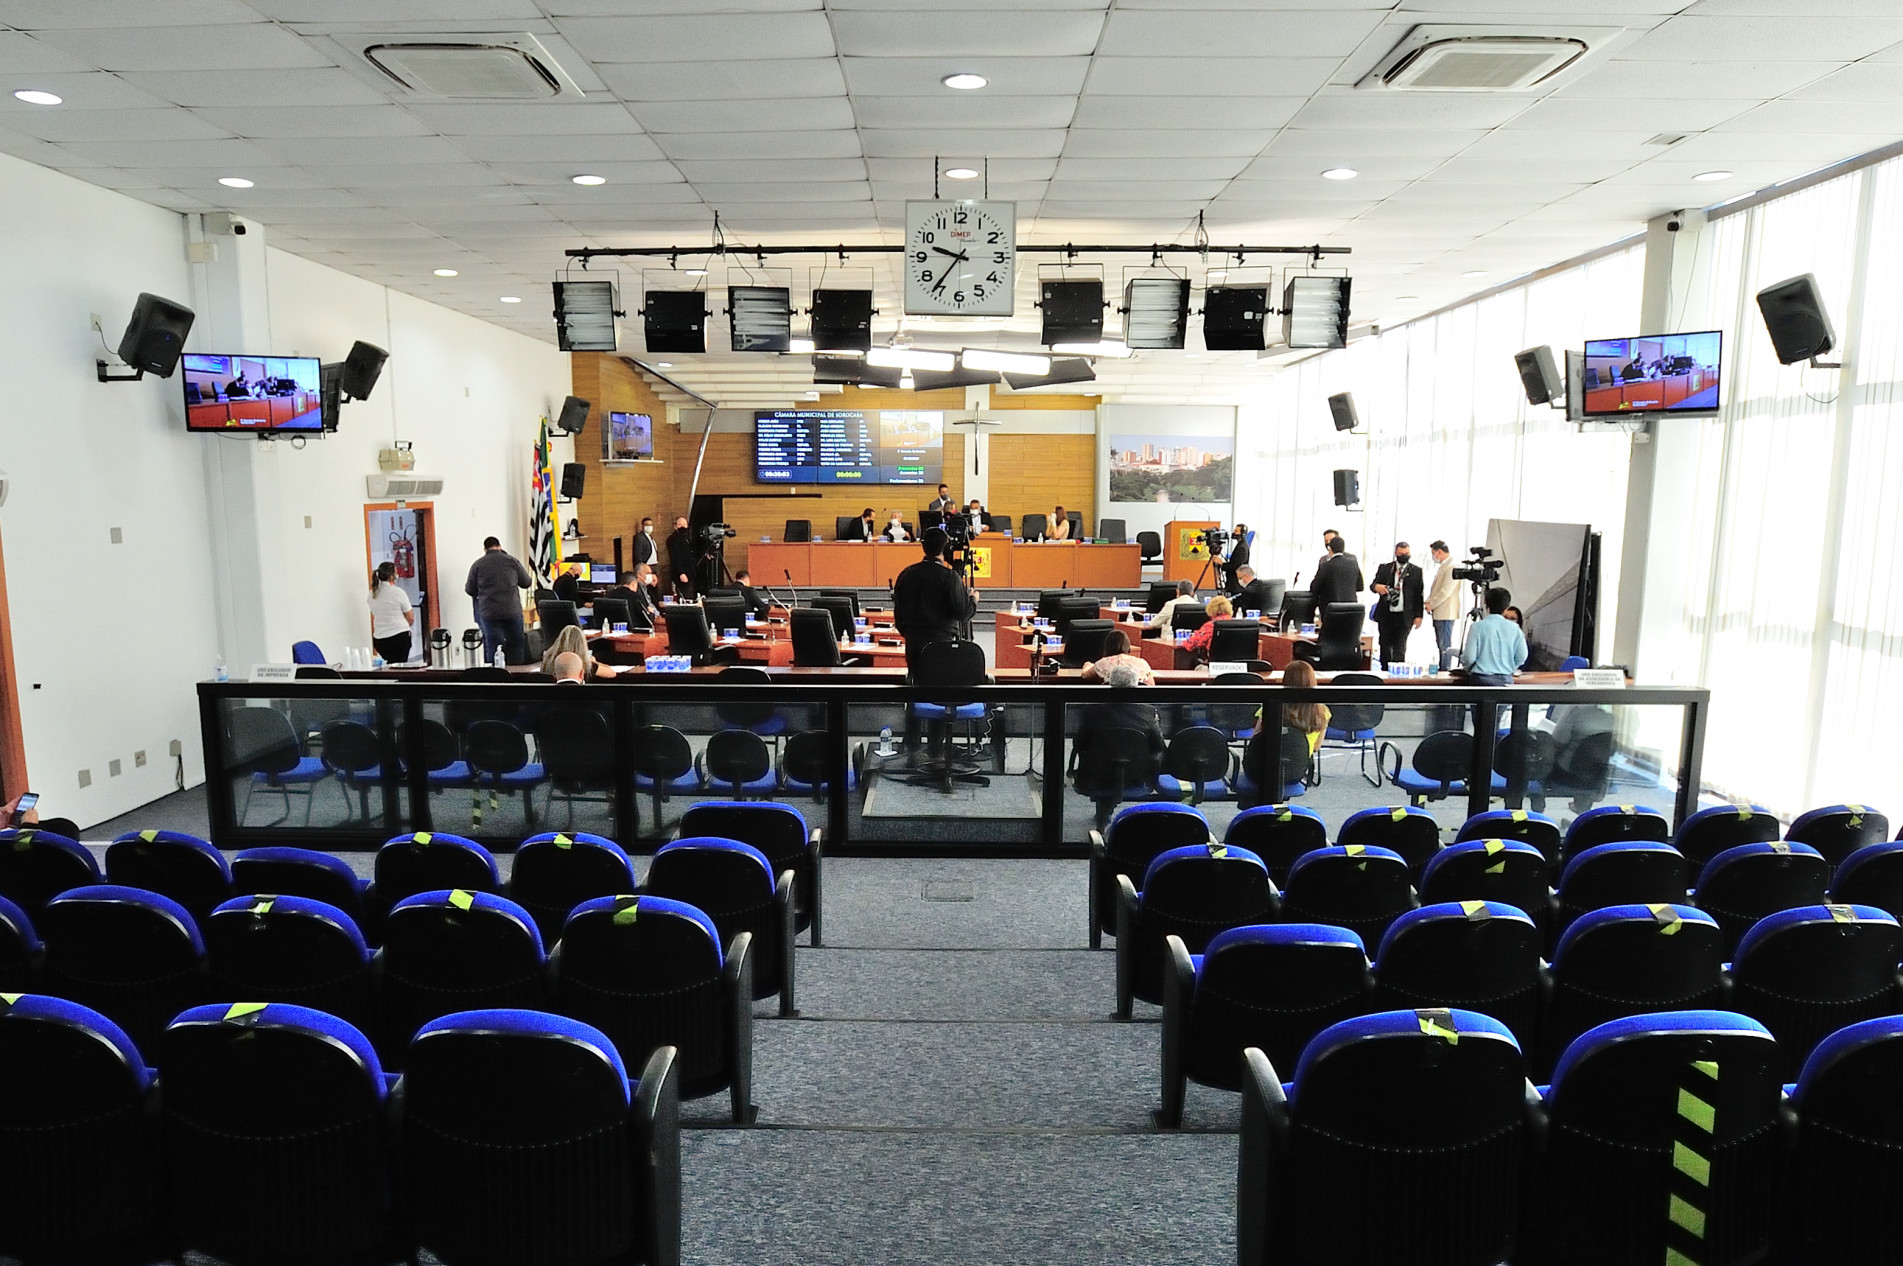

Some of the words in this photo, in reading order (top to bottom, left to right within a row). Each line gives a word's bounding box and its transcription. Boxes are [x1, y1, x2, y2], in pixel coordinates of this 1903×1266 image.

[937, 217, 946, 230] 11
[953, 211, 968, 224] 12
[978, 217, 982, 230] 1
[922, 231, 935, 244] 10
[987, 231, 999, 244] 2
[916, 251, 928, 263] 9
[992, 251, 1005, 264] 3
[921, 270, 933, 282] 8
[986, 270, 998, 283] 4
[937, 285, 946, 297] 7
[953, 291, 965, 302] 6
[973, 284, 985, 297] 5
